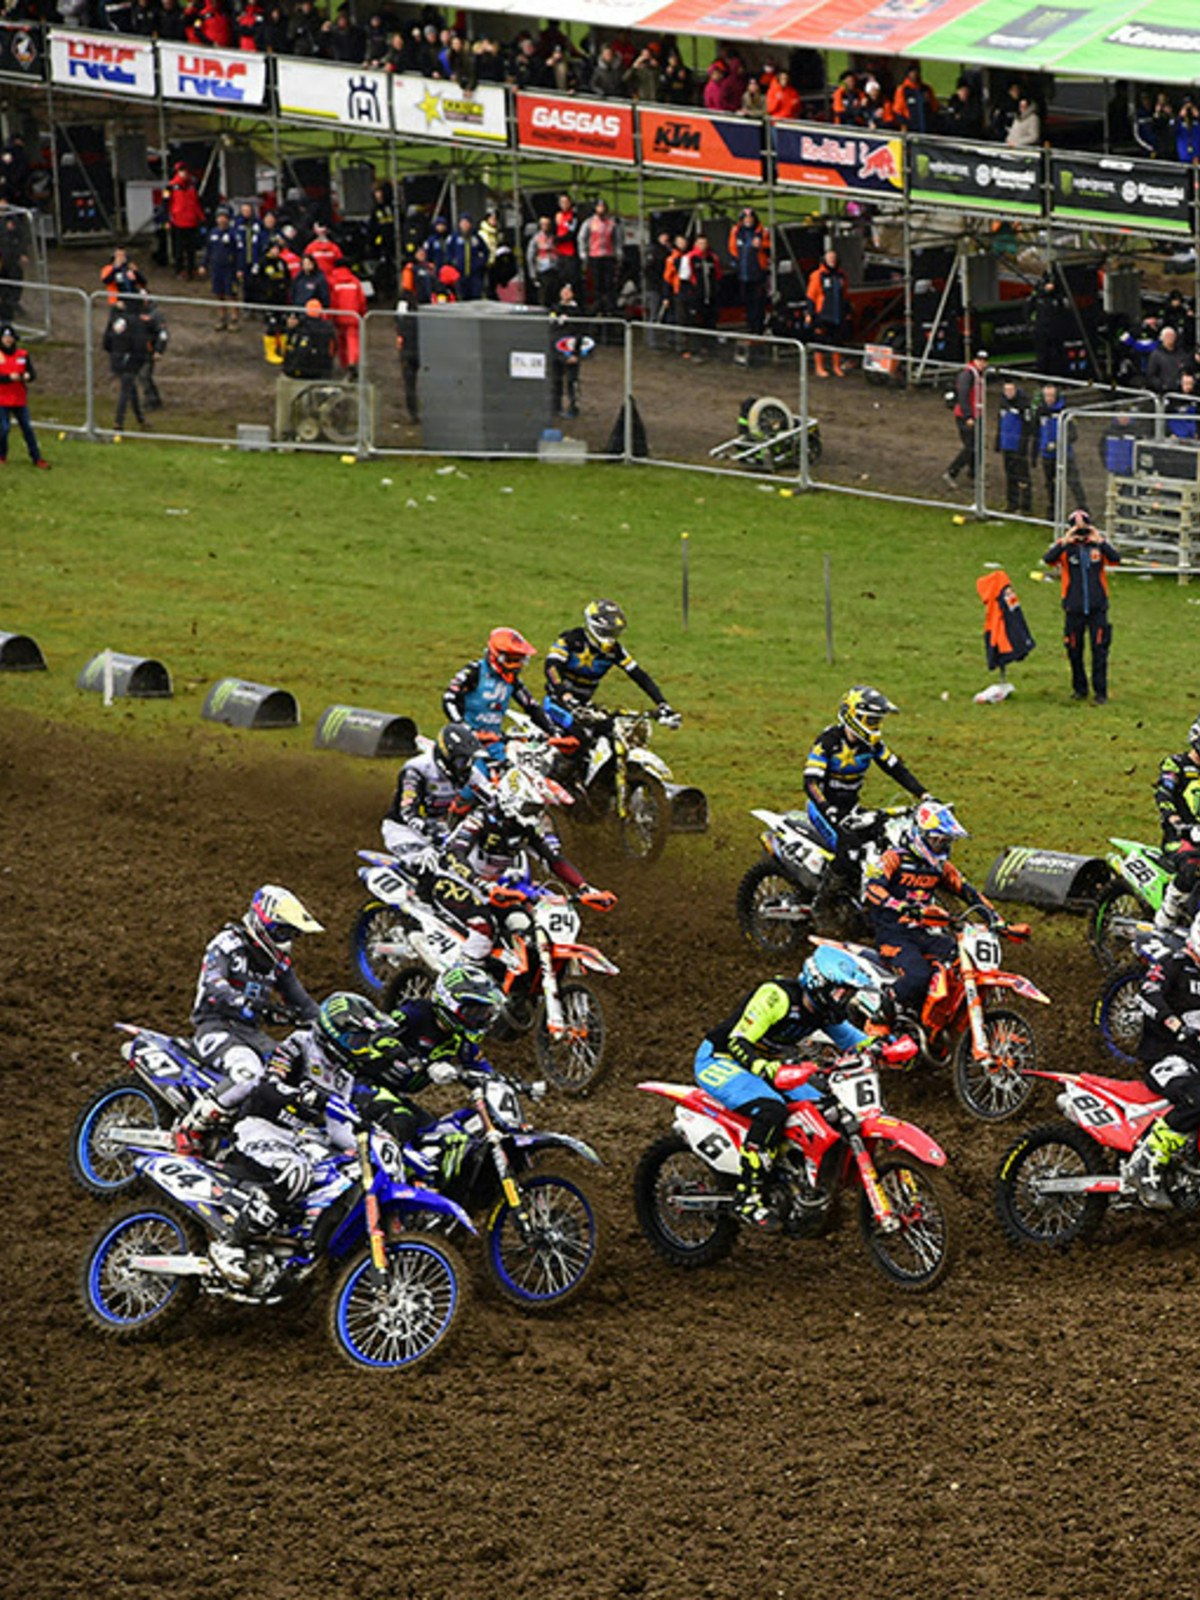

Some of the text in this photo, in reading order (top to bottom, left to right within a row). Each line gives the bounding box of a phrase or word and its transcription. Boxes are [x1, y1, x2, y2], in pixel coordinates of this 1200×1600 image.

[531, 106, 621, 138] GASGAS
[655, 121, 702, 151] KTM
[372, 873, 403, 894] 10
[549, 912, 577, 933] 24
[428, 930, 456, 955] 24
[976, 941, 998, 962] 61
[856, 1081, 875, 1107] 6
[1072, 1094, 1114, 1127] 85
[696, 1133, 731, 1161] 6
